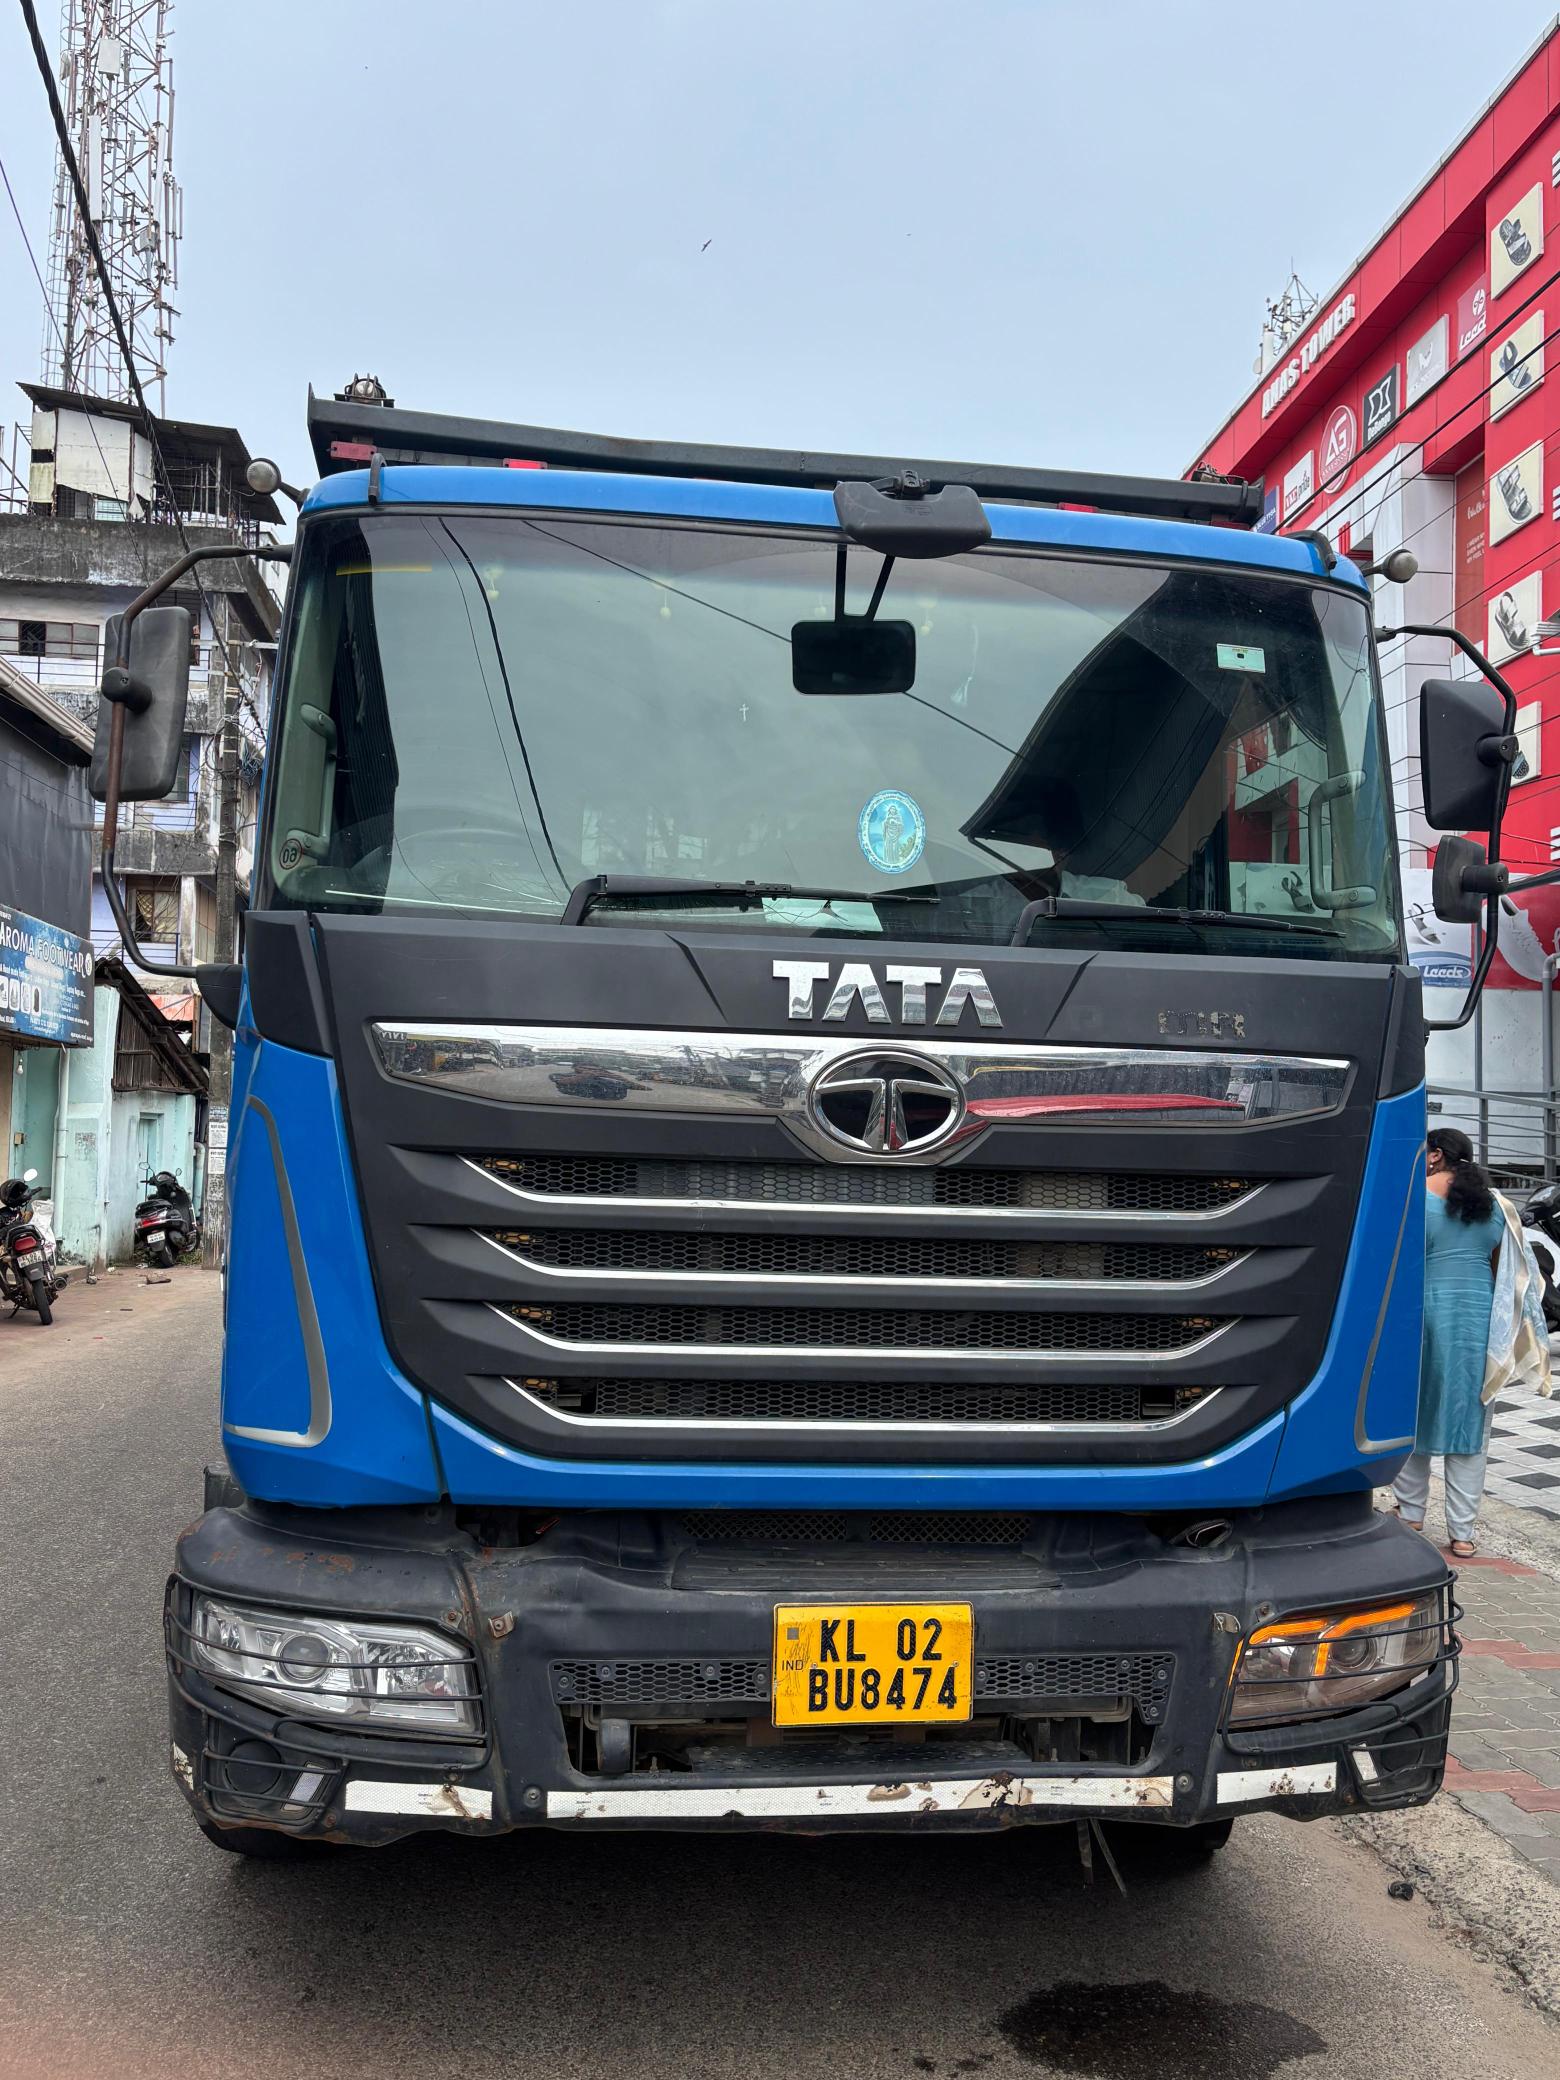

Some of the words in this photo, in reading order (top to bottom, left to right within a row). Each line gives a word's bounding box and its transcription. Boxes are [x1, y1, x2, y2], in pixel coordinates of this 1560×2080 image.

[1300, 293, 1355, 374] TOWER
[0, 922, 35, 957] AROMA
[37, 938, 86, 979] FOOTWEAR
[1423, 965, 1464, 979] Leeds
[772, 959, 1004, 1029] TATA
[819, 1619, 866, 1663] KL
[896, 1617, 943, 1661] 02
[781, 1659, 805, 1671] IND
[808, 1666, 958, 1713] BU8474
